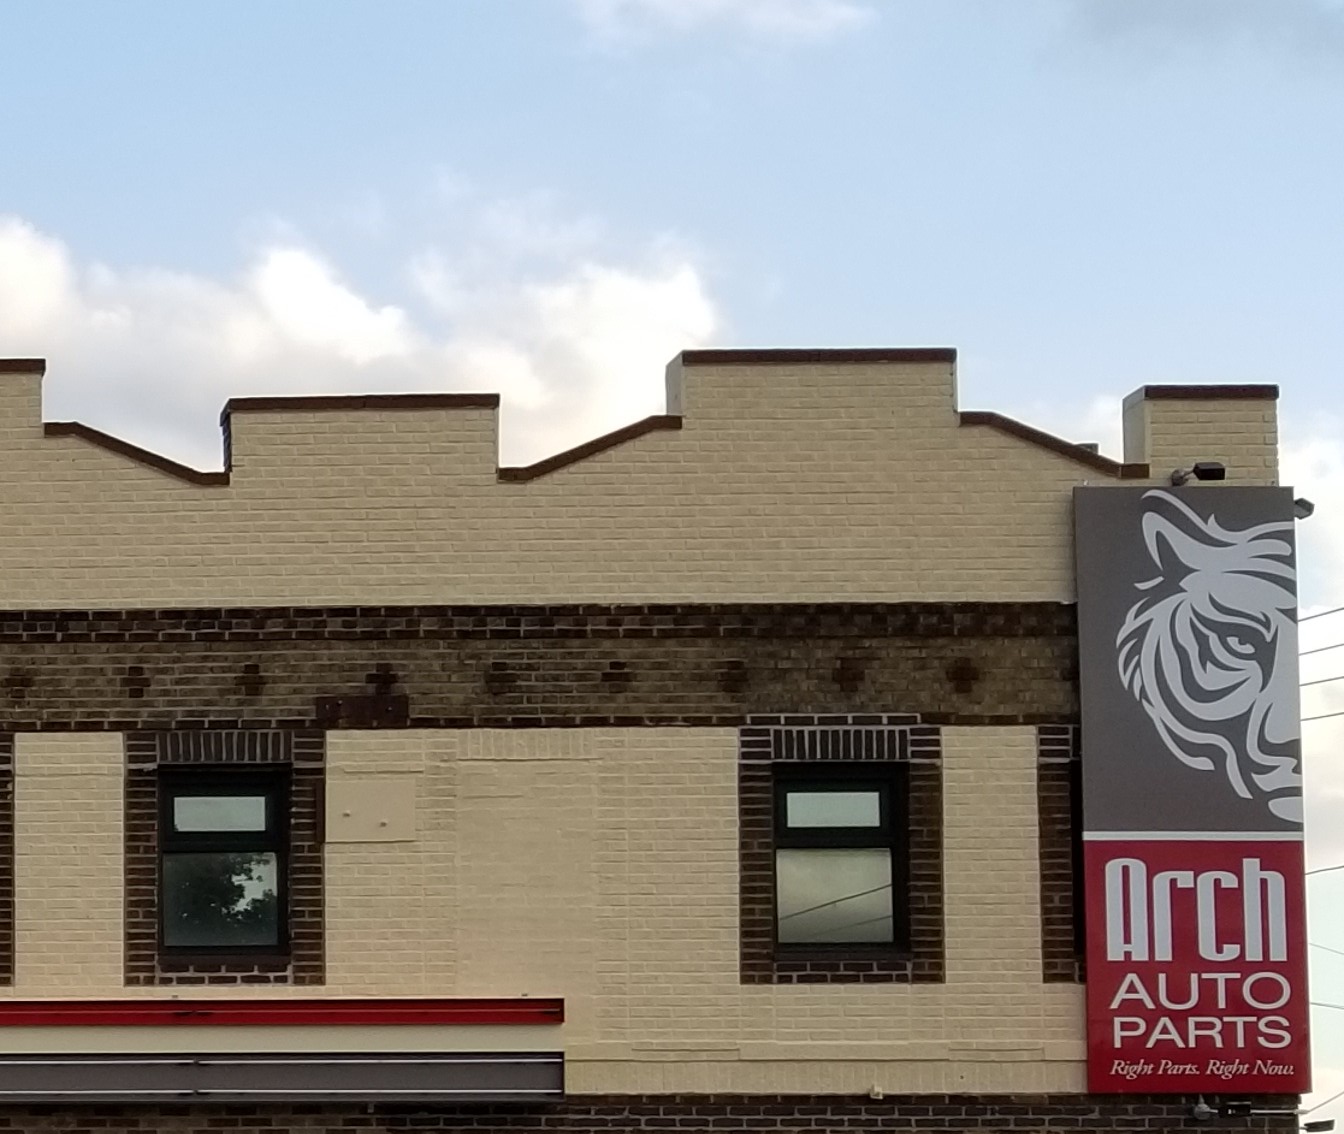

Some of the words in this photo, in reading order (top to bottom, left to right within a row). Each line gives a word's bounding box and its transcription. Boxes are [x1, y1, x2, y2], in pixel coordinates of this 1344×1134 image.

[1105, 857, 1288, 962] Arch
[1109, 971, 1292, 1011] AUTO
[1112, 1015, 1293, 1049] PARTS
[1109, 1058, 1153, 1080] Right
[1157, 1058, 1201, 1076] Parts.
[1205, 1058, 1250, 1080] Right
[1252, 1059, 1295, 1076] Now.
